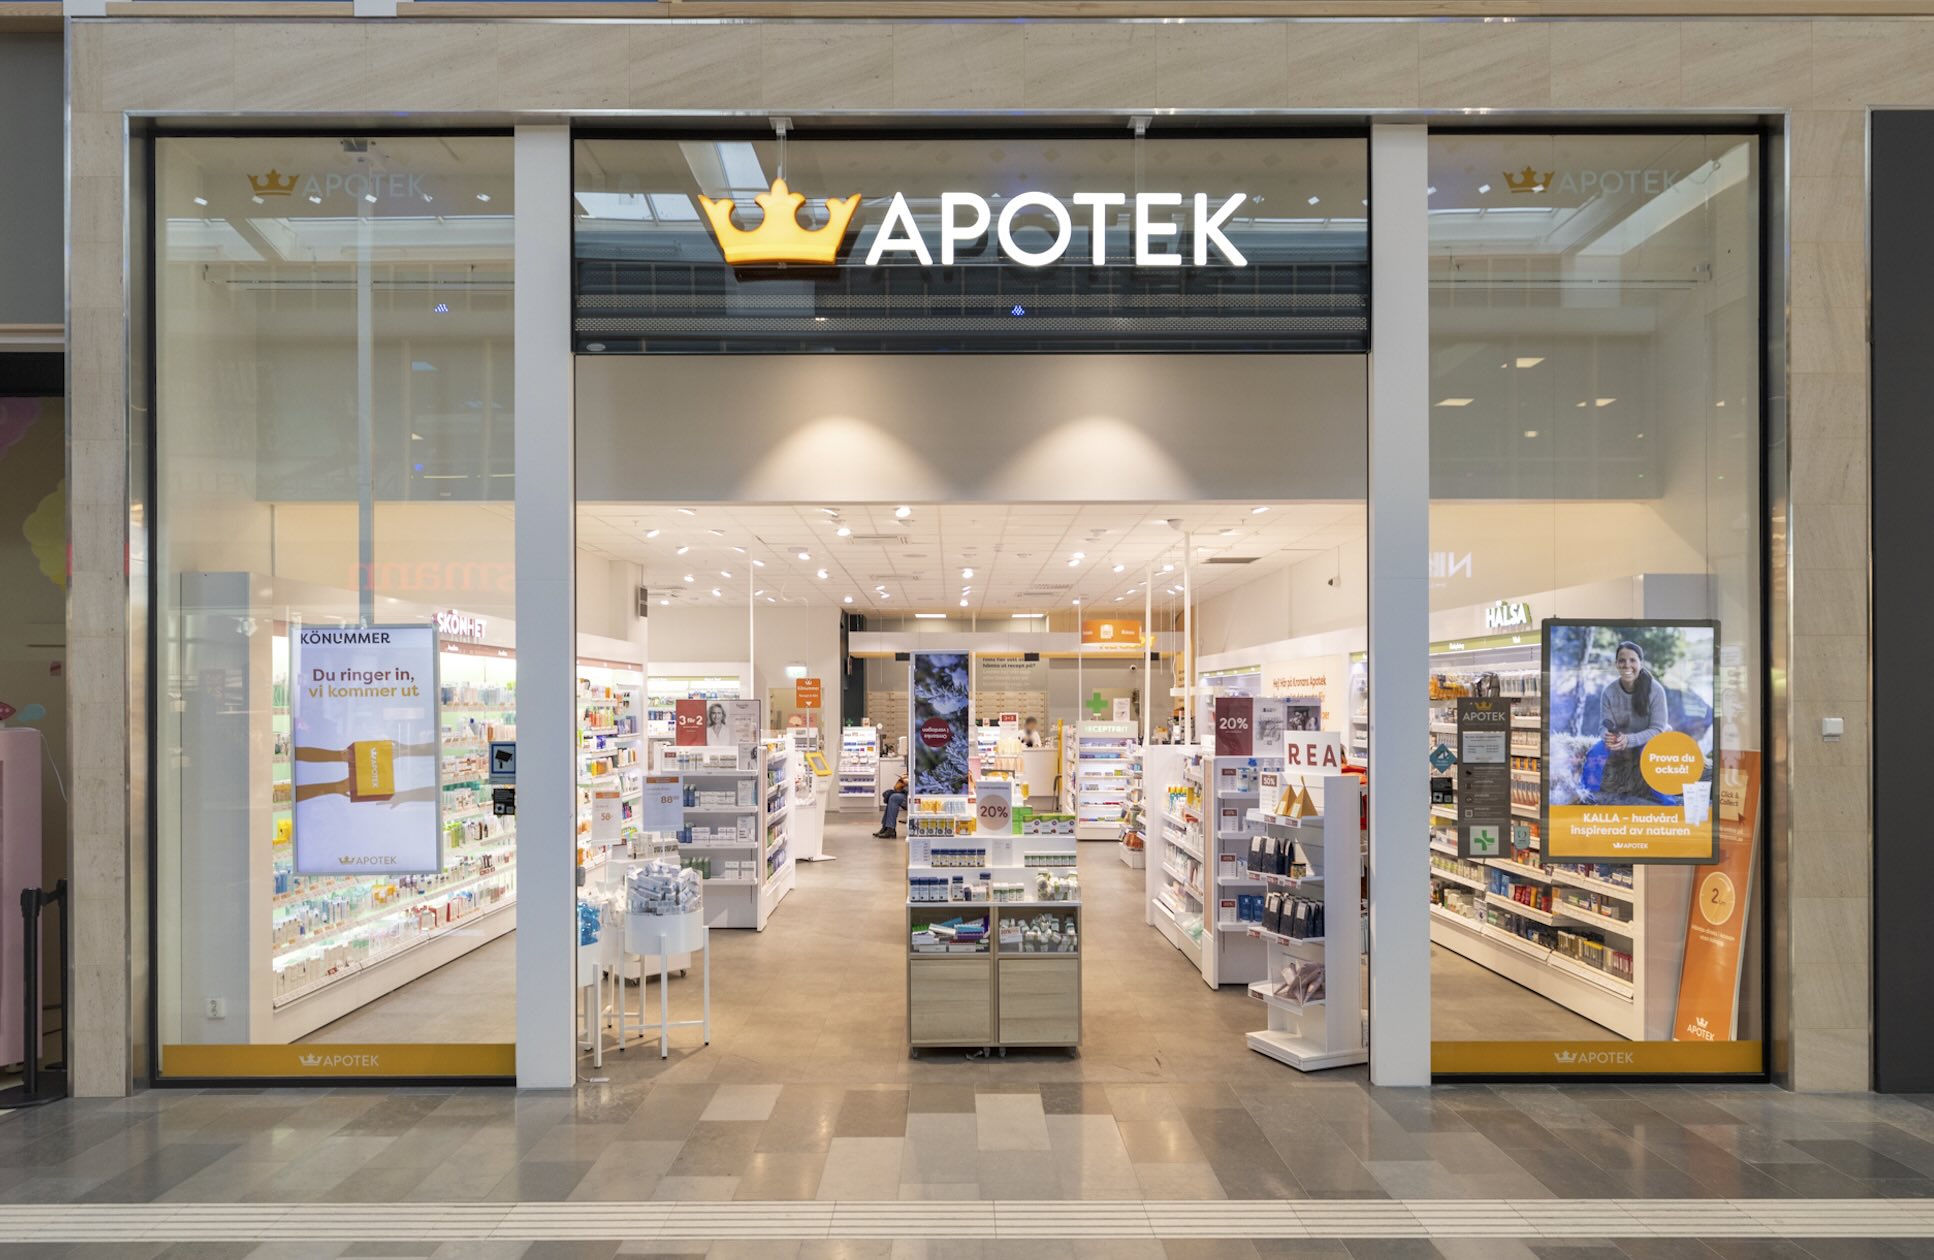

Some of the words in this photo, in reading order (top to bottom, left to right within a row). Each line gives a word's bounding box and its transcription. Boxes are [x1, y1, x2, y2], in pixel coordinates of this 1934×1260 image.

[303, 173, 424, 197] APOTEK
[1558, 170, 1680, 194] APOTEK
[865, 191, 1248, 267] APOTEK
[437, 609, 487, 638] SKÖNHET
[301, 631, 390, 644] KÖNUMMER
[313, 668, 335, 682] Du
[341, 668, 391, 684] ringer
[395, 667, 415, 682] in,
[309, 685, 323, 698] vi
[328, 685, 397, 697] kommer
[401, 685, 420, 697] ut
[679, 715, 687, 726] 3
[696, 715, 703, 726] 2
[1462, 711, 1506, 721] APOTEK
[1219, 717, 1249, 730] 20%
[1288, 743, 1338, 768] REA
[1649, 753, 1679, 762] Prova
[1681, 753, 1695, 763] du
[1655, 765, 1689, 774] också!
[980, 805, 1009, 818] 20%
[1583, 813, 1620, 823] KALLA
[1632, 812, 1678, 823] hudvård
[1570, 825, 1626, 837] inspirerad
[1629, 827, 1643, 835] av
[1646, 826, 1690, 835] naturen
[356, 856, 397, 865] APOTEK
[1711, 887, 1719, 904] 2
[1687, 1024, 1715, 1041] APOTEK
[323, 1055, 379, 1066] APOTEK
[1577, 1052, 1634, 1064] APOTEK
